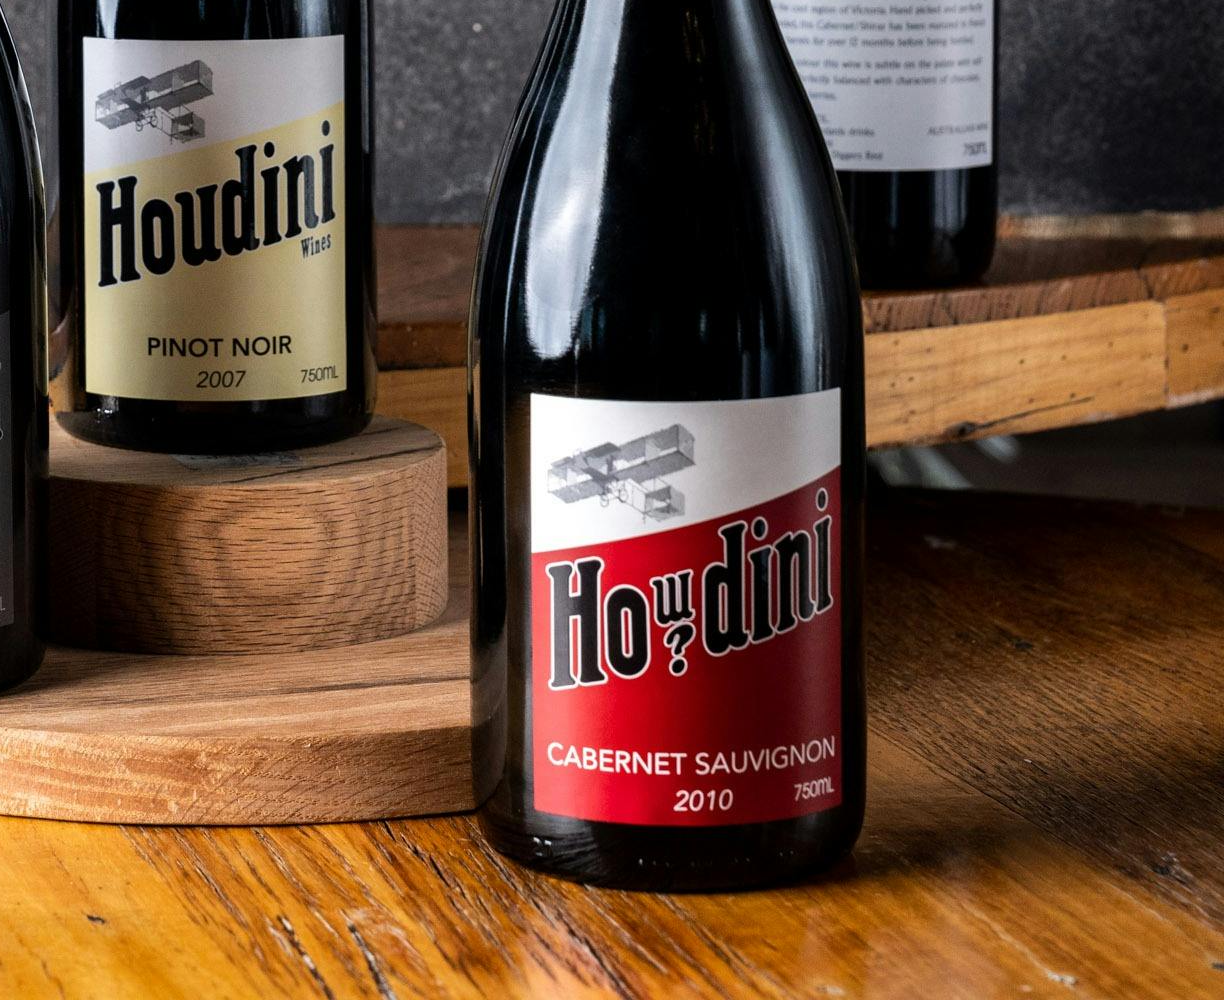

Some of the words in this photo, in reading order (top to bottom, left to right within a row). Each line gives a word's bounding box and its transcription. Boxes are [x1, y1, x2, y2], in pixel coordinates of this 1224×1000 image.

[95, 120, 336, 287] Houdini
[300, 231, 332, 259] Wines
[147, 337, 224, 358] PINOT
[232, 335, 292, 357] NOIR
[196, 370, 246, 388] 2007
[547, 741, 687, 775] CABERNET
[694, 735, 836, 776] SAUVIGNON
[673, 788, 734, 812] 2010
